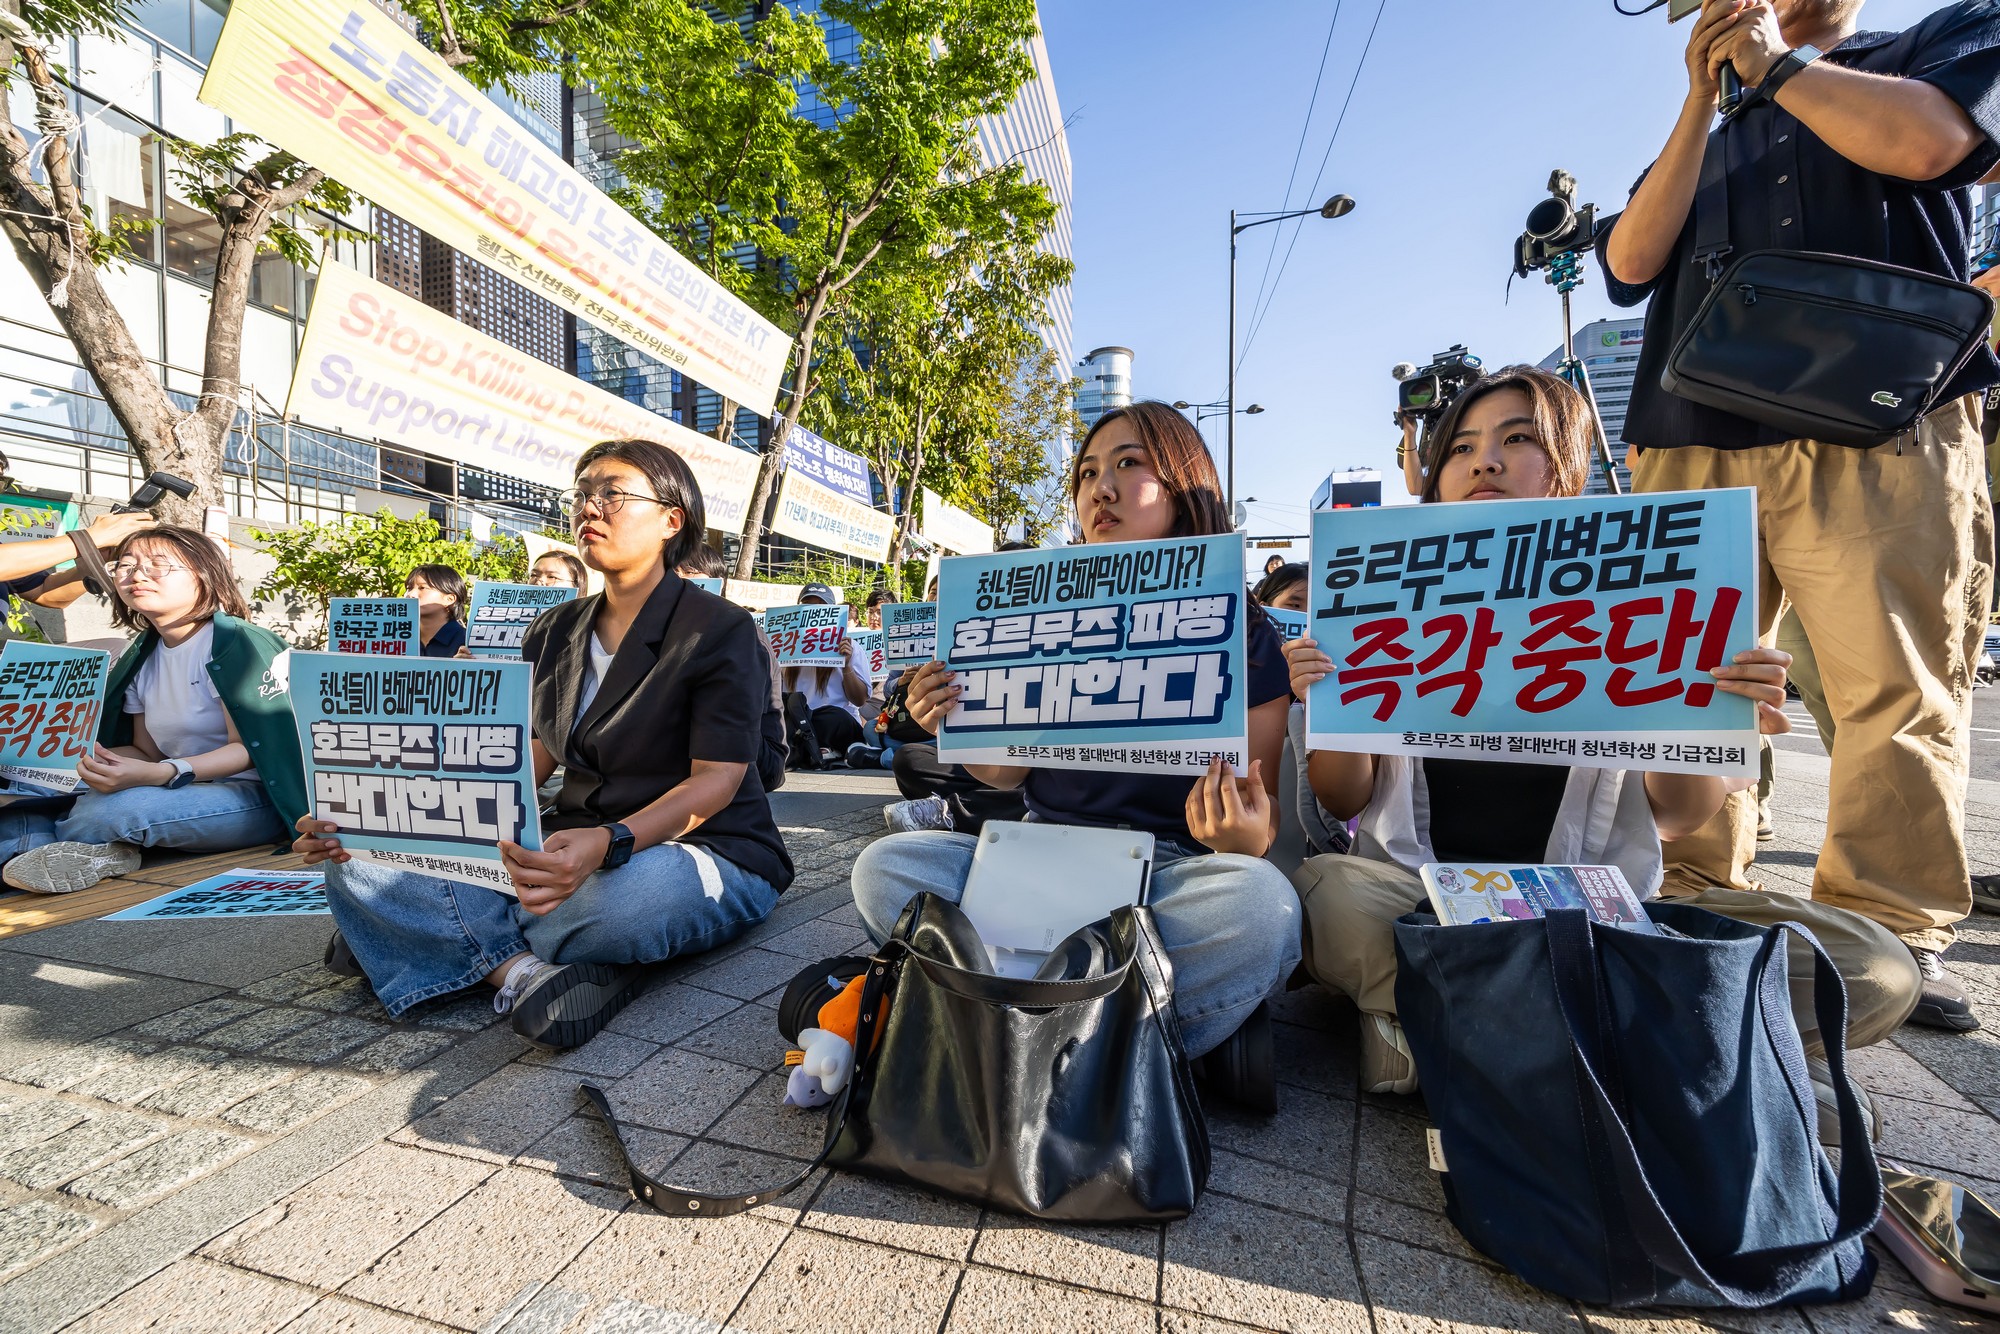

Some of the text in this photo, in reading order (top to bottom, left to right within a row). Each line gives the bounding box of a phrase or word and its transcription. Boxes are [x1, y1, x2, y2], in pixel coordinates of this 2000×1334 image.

[273, 44, 537, 240] 정경유착의
[535, 227, 610, 288] 온상
[607, 274, 676, 332] KT를
[329, 10, 771, 351] 노동자 해고와 노조 탄압의 표본 KT
[476, 234, 689, 367] 헬조선변혁 전국추진위원회
[311, 353, 492, 434] Support
[338, 291, 448, 374] Stop
[450, 341, 558, 422] Killing
[687, 443, 752, 486] People!
[975, 543, 1207, 612] 청년들이 방패막이인가?!
[1316, 500, 1706, 620] 호르무즈 파병검토
[341, 603, 408, 617] 호르무즈 해협
[474, 605, 538, 622] 호르무즈
[488, 589, 519, 605] 청년들이
[766, 611, 800, 634] 호르무즈
[800, 607, 840, 628] 파병검토
[893, 608, 915, 623] 청년들이
[334, 620, 412, 639] 한국군 파병
[771, 626, 844, 658] 즉각 중단!
[888, 622, 936, 639] 호르무즈
[951, 594, 1232, 658] 호르무즈 파병
[1338, 586, 1743, 723] 즉각 중단!
[0, 656, 104, 701] 호르무즈 파병검토
[319, 669, 502, 716] 청년들이 방패막이인가?!
[946, 652, 1226, 728] 반대한다
[37, 699, 100, 759] 중단!
[310, 721, 519, 768] 호르무즈 파병
[1402, 731, 1747, 766] 호르무즈 파병 절대반대 청년학생 긴급집회
[1006, 744, 1051, 760] 호르무즈
[1053, 746, 1076, 762] 파병
[1078, 747, 1127, 764] 절대반대
[1130, 749, 1182, 765] 청년학생
[314, 771, 521, 843] 반대한다
[370, 849, 404, 864] 호르무즈
[405, 854, 424, 868] 파병
[425, 857, 463, 875] 절대반대
[464, 863, 500, 883] 청년학생
